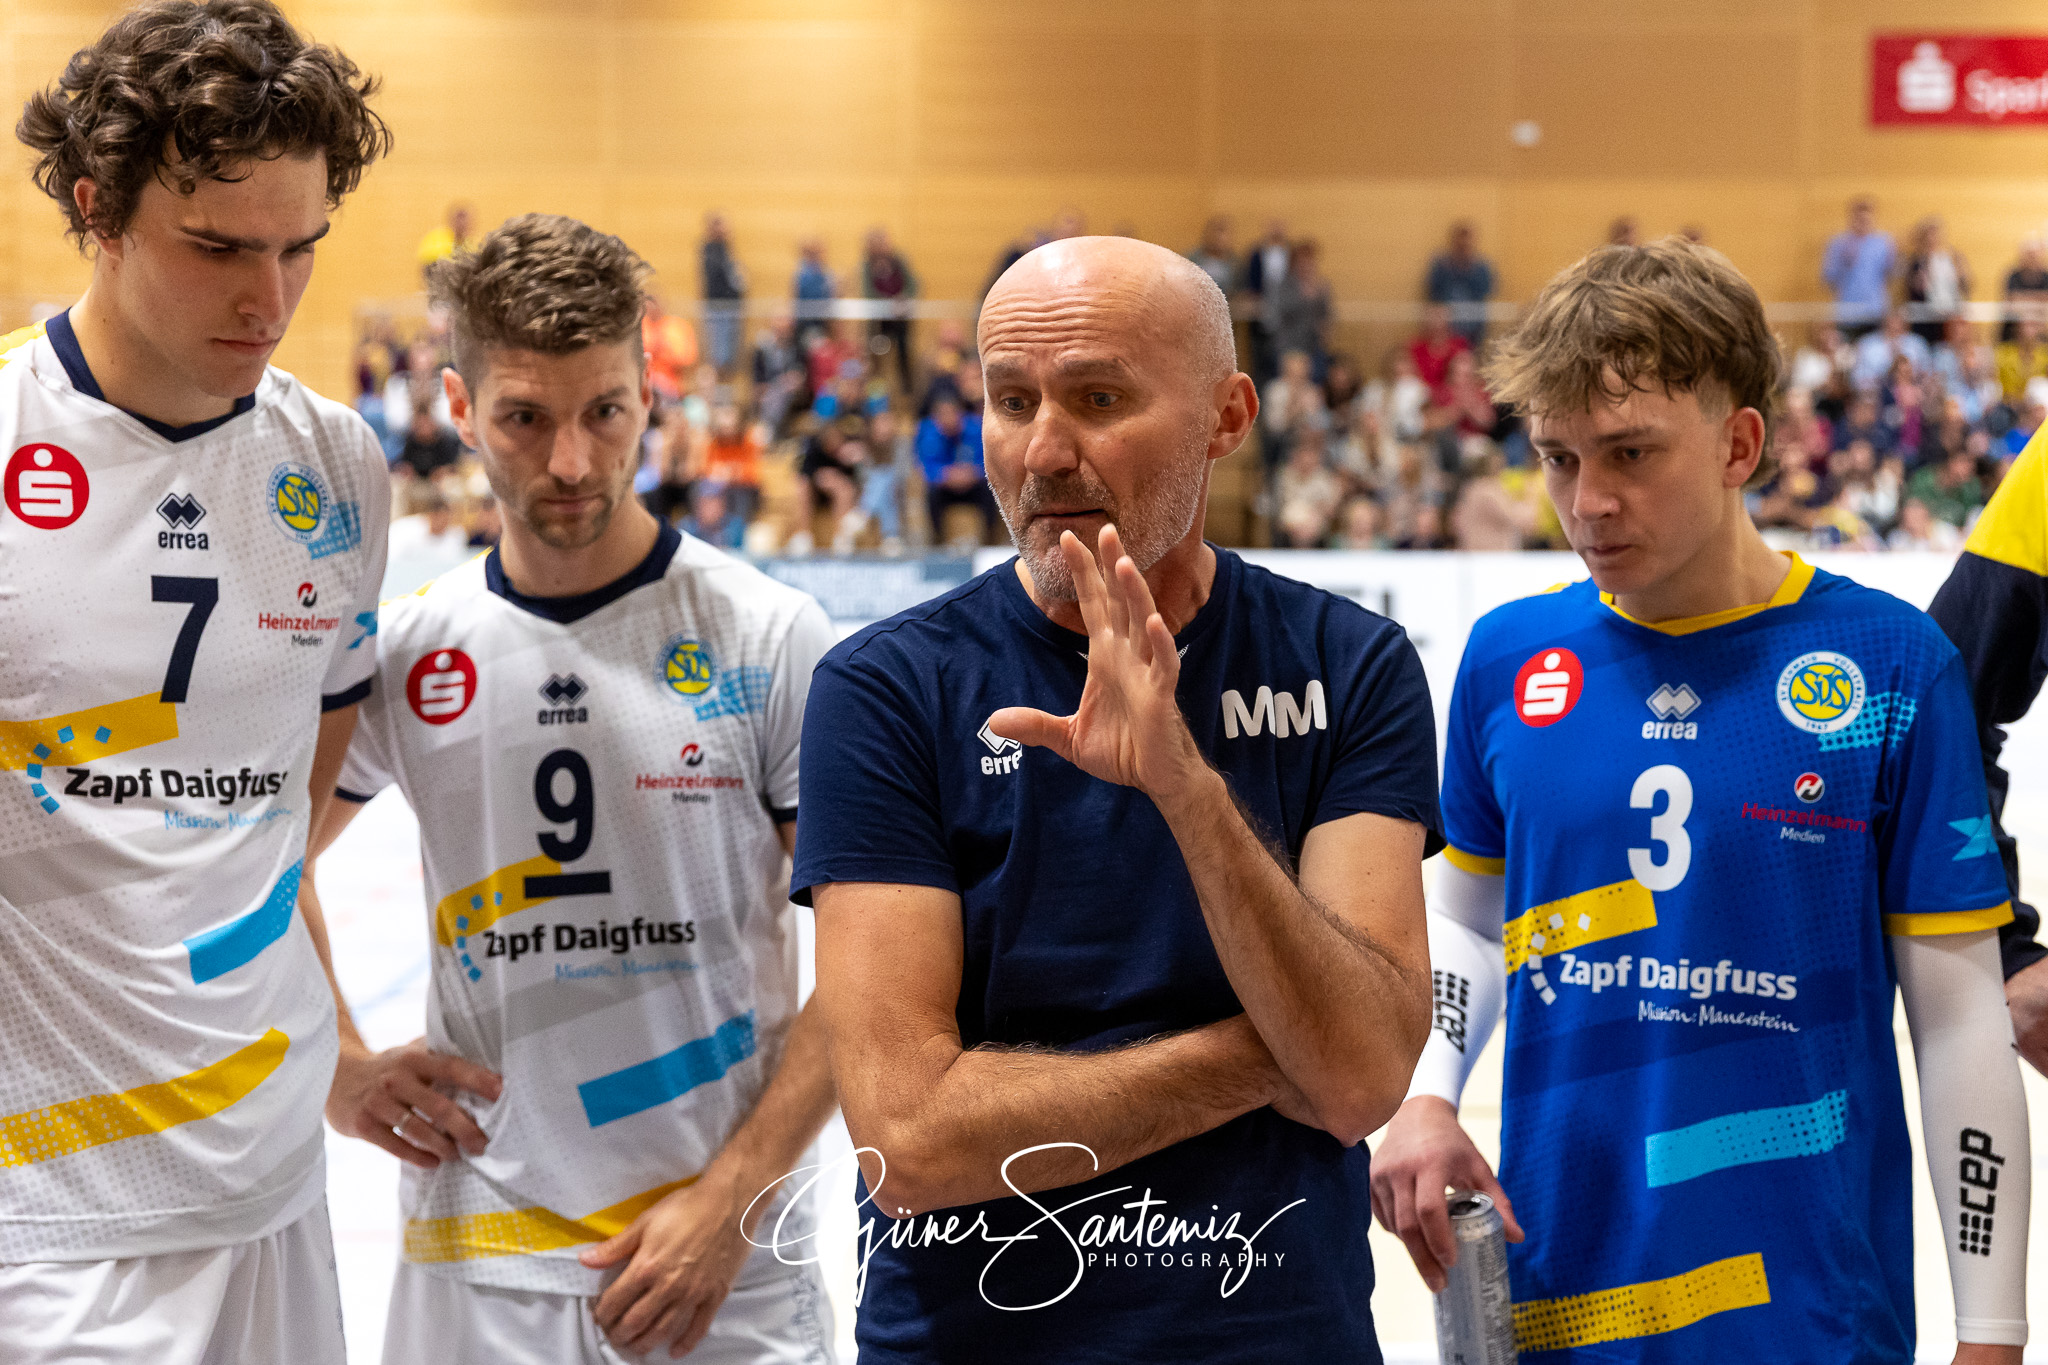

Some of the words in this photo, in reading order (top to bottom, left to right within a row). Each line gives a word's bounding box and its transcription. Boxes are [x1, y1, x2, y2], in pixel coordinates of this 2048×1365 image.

[157, 530, 209, 551] errea
[151, 575, 220, 704] 7
[537, 704, 589, 726] errea
[1641, 721, 1698, 740] errea
[981, 745, 1023, 775] erre
[64, 767, 153, 805] Zapf
[635, 770, 744, 791] Heinzelmann
[533, 747, 595, 863] 9
[1741, 802, 1867, 834] Heinzelmann
[1627, 764, 1693, 893] 3
[1780, 825, 1826, 845] Medien
[484, 924, 546, 963] Zapf
[553, 917, 696, 956] Daigfuss
[1559, 953, 1633, 994] Zapf
[1639, 957, 1798, 1001] Daigfuss
[1699, 1003, 1800, 1033] Mauerstein
[1959, 1127, 2006, 1215] cep
